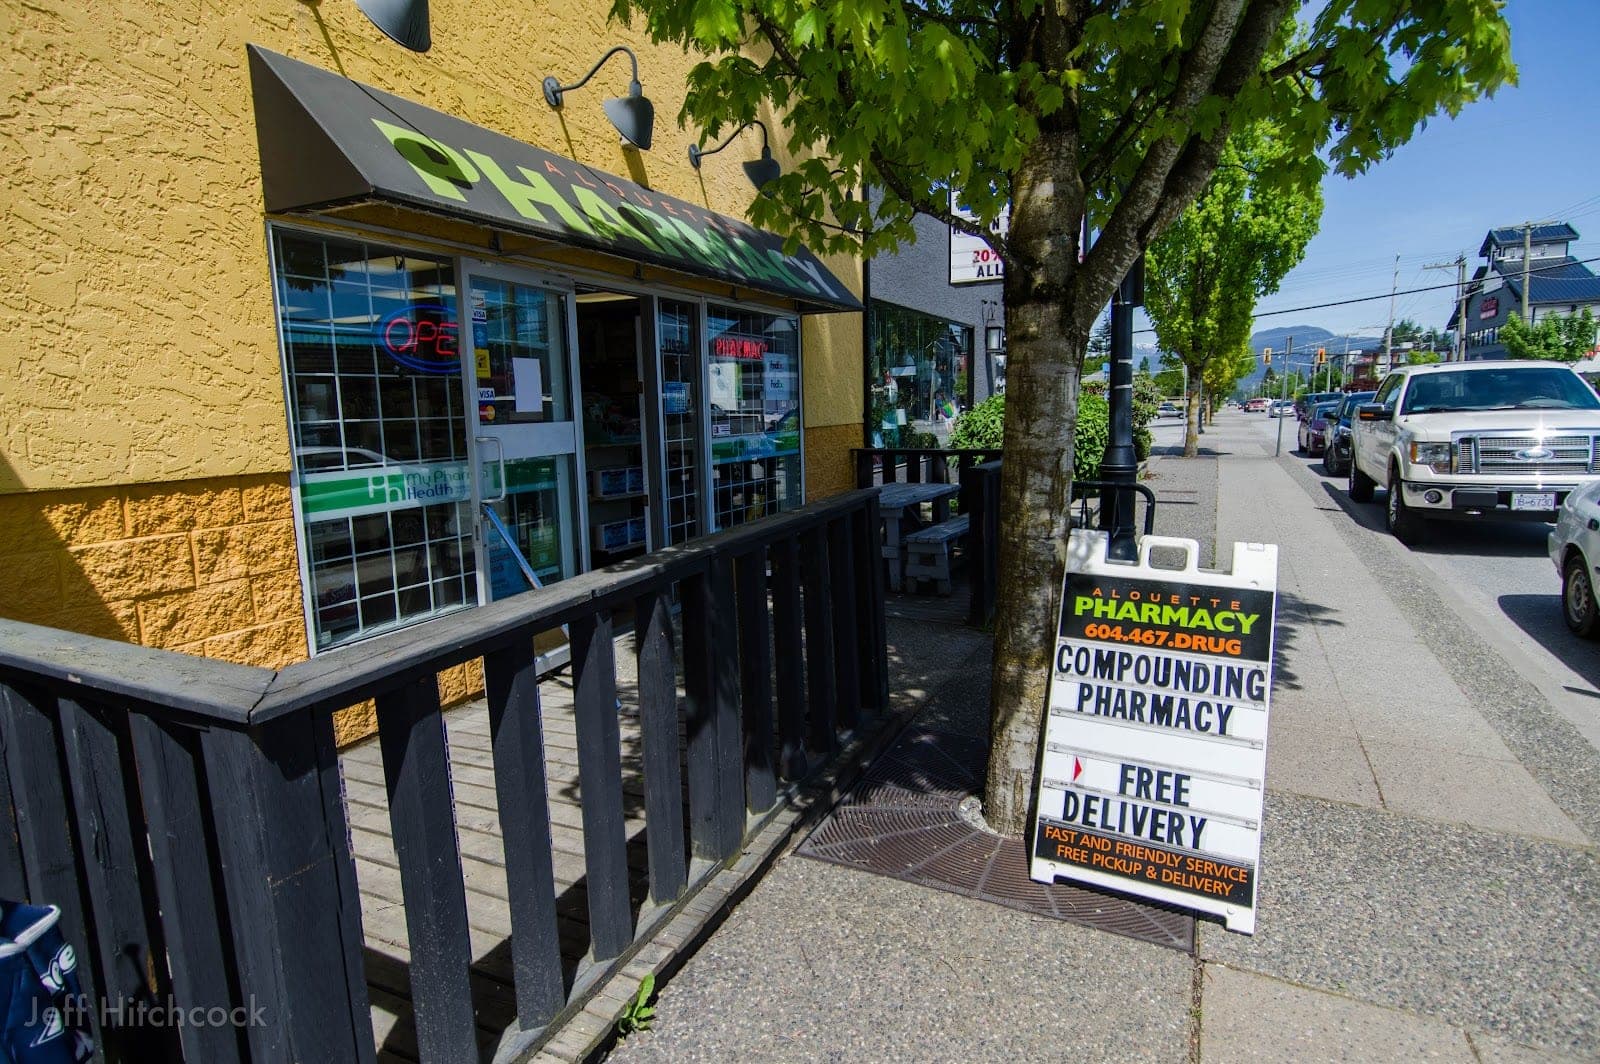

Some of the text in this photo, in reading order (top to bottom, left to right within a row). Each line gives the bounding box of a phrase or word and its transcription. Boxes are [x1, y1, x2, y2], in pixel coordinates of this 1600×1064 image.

[371, 118, 840, 299] PHARMACY
[976, 263, 1003, 278] ALL
[473, 310, 486, 319] VISA
[385, 316, 463, 356] OPE
[479, 390, 495, 399] VISA
[408, 484, 453, 500] Health
[1074, 596, 1260, 634] PHARMACY
[1092, 587, 1240, 611] ALOUETTE
[1085, 623, 1242, 655] 604.467.DRUG
[1057, 644, 1265, 701] COMPOUNDING
[1078, 682, 1233, 735] PHARMACY
[1119, 763, 1191, 807] FREE
[1062, 790, 1208, 849] DELIVERY
[1045, 826, 1248, 883] FAST AND FRIENDLY SERVICE
[1057, 845, 1233, 897] FREE PICKUP & DELIVERY
